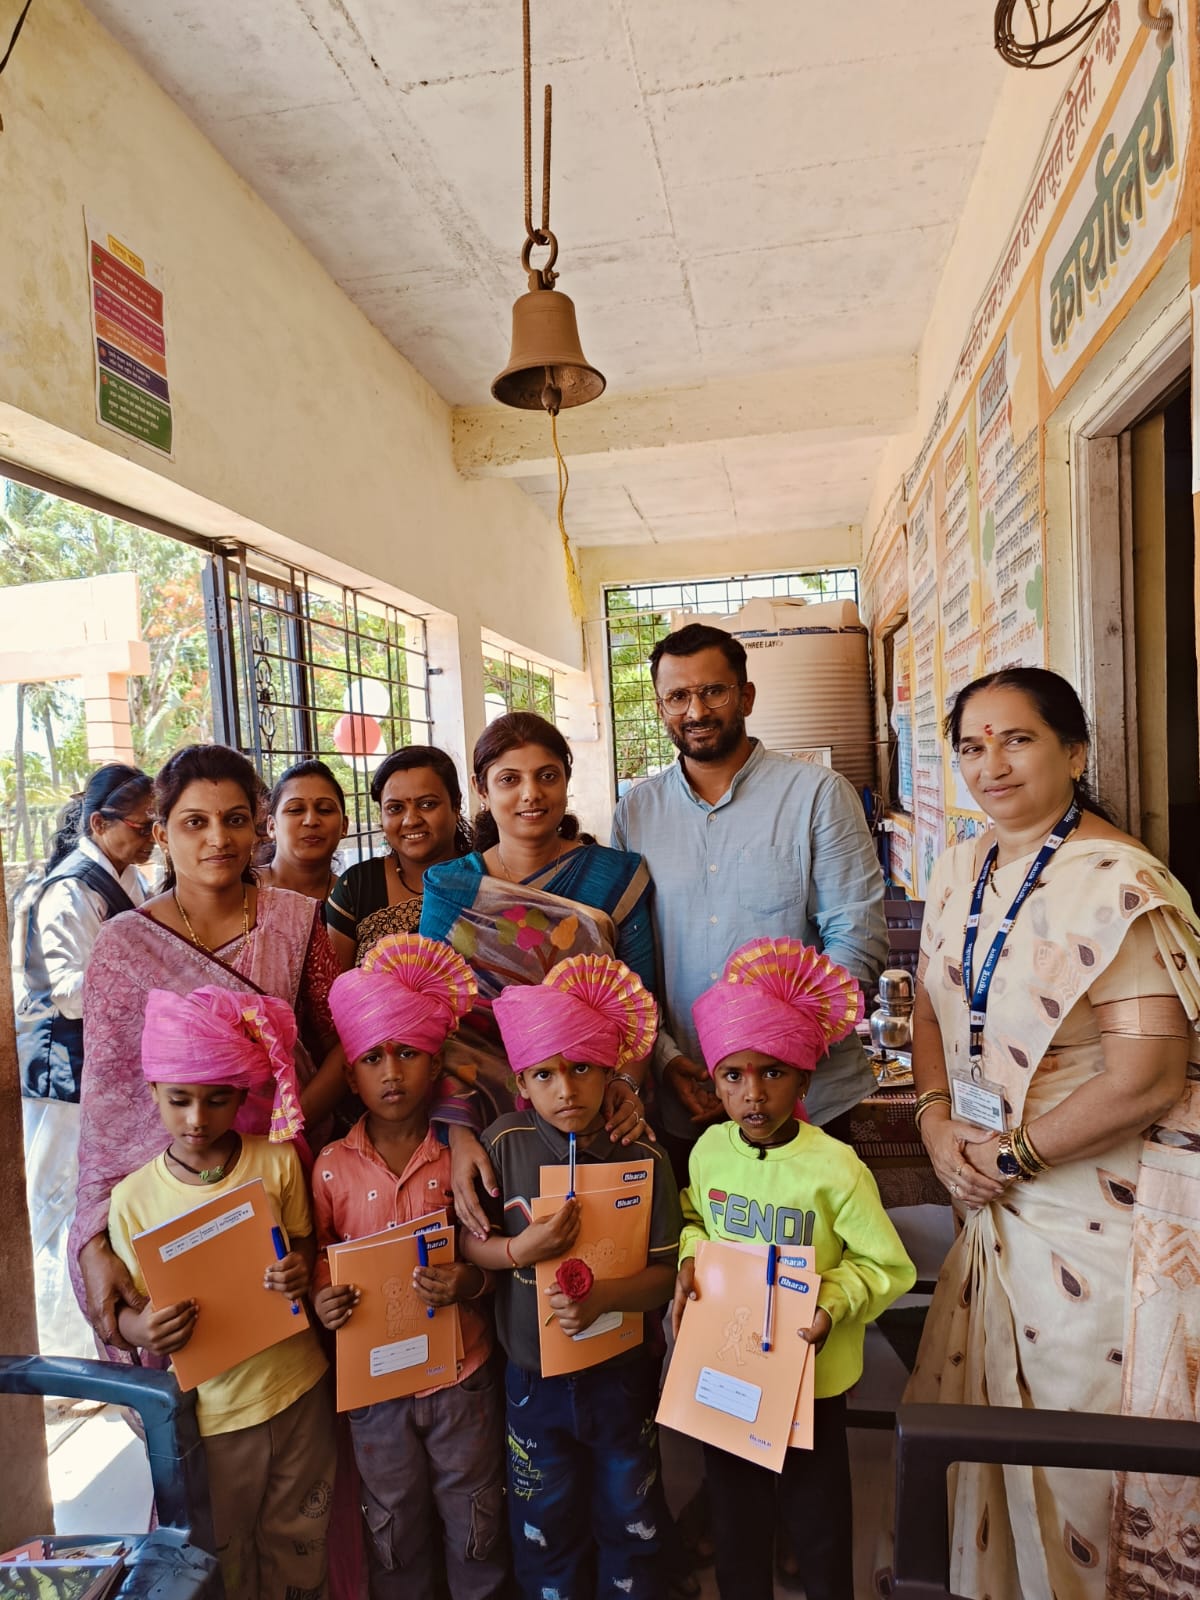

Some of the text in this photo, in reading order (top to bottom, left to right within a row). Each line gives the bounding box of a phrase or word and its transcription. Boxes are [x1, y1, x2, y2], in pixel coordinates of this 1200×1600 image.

[1020, 123, 1064, 247] घरापासून
[1049, 42, 1177, 347] कार्यालय
[744, 640, 784, 649] THREE LAY
[624, 1172, 646, 1180] Bharat
[617, 1197, 639, 1207] Bharat
[708, 1188, 816, 1246] FENDI
[780, 1277, 807, 1292] Bharat
